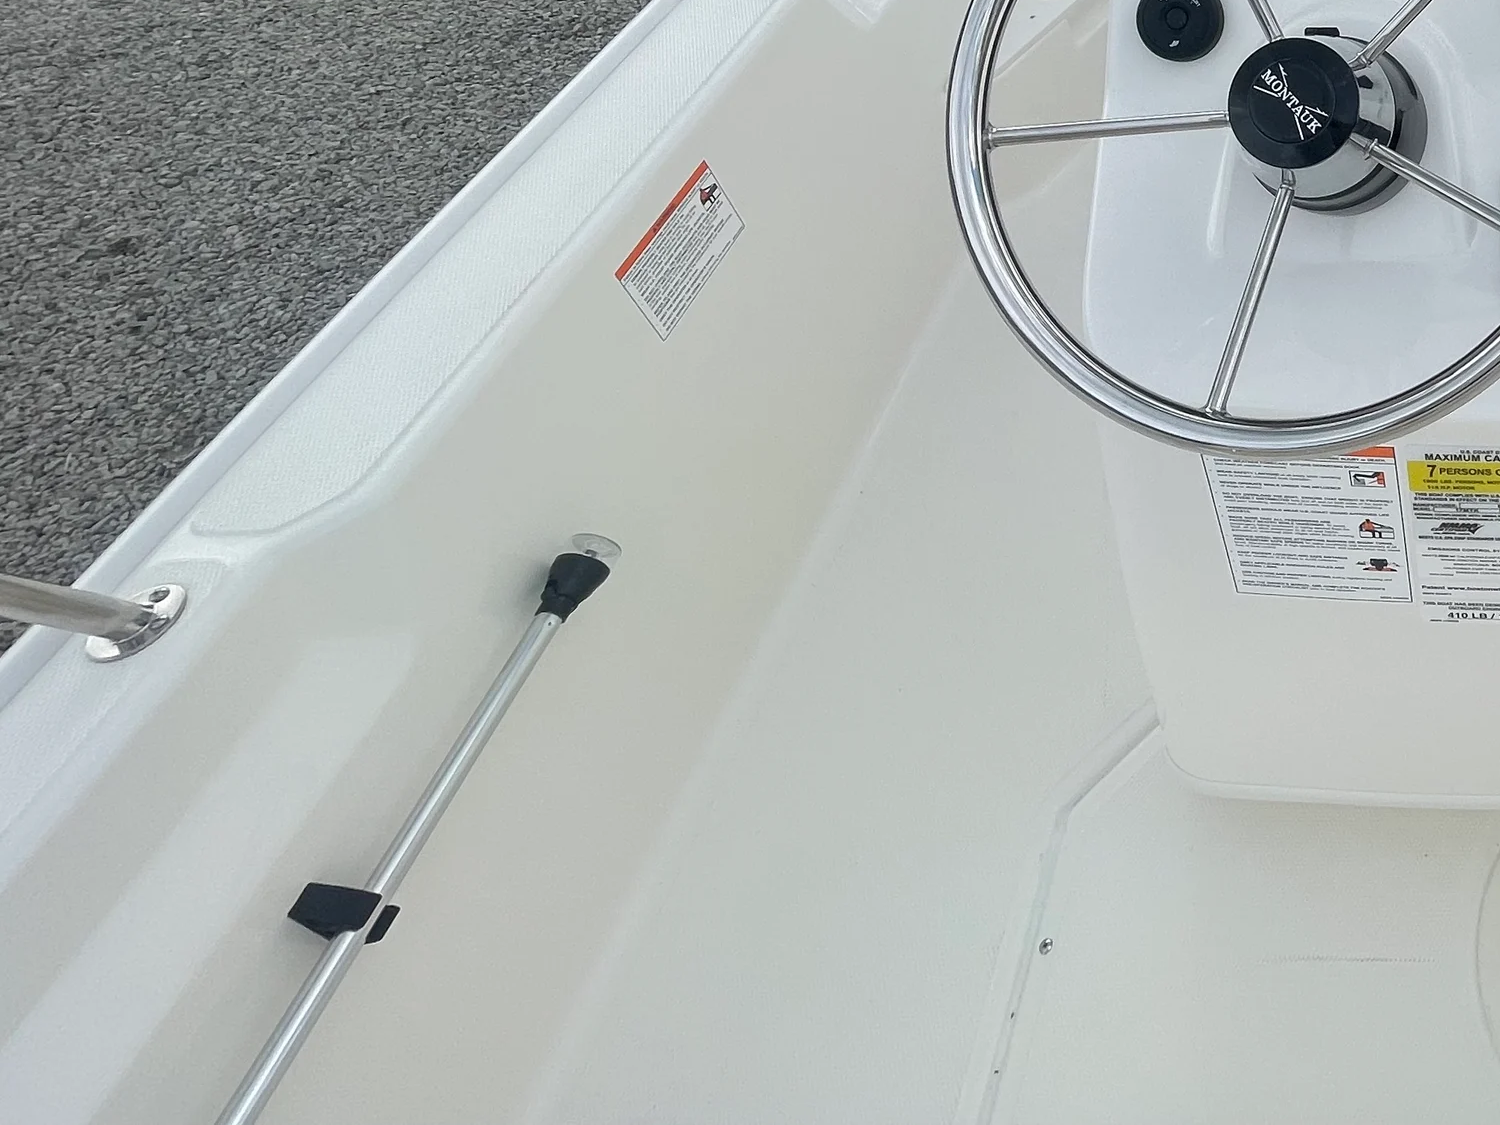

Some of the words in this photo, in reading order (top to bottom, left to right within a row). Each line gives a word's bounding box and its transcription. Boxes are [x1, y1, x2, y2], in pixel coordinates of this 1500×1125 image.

[1260, 68, 1324, 136] MONTAUK
[1424, 453, 1480, 462] MAXIMUM
[1427, 464, 1437, 478] 7
[1439, 467, 1492, 476] PERSONS
[1472, 612, 1488, 620] LB
